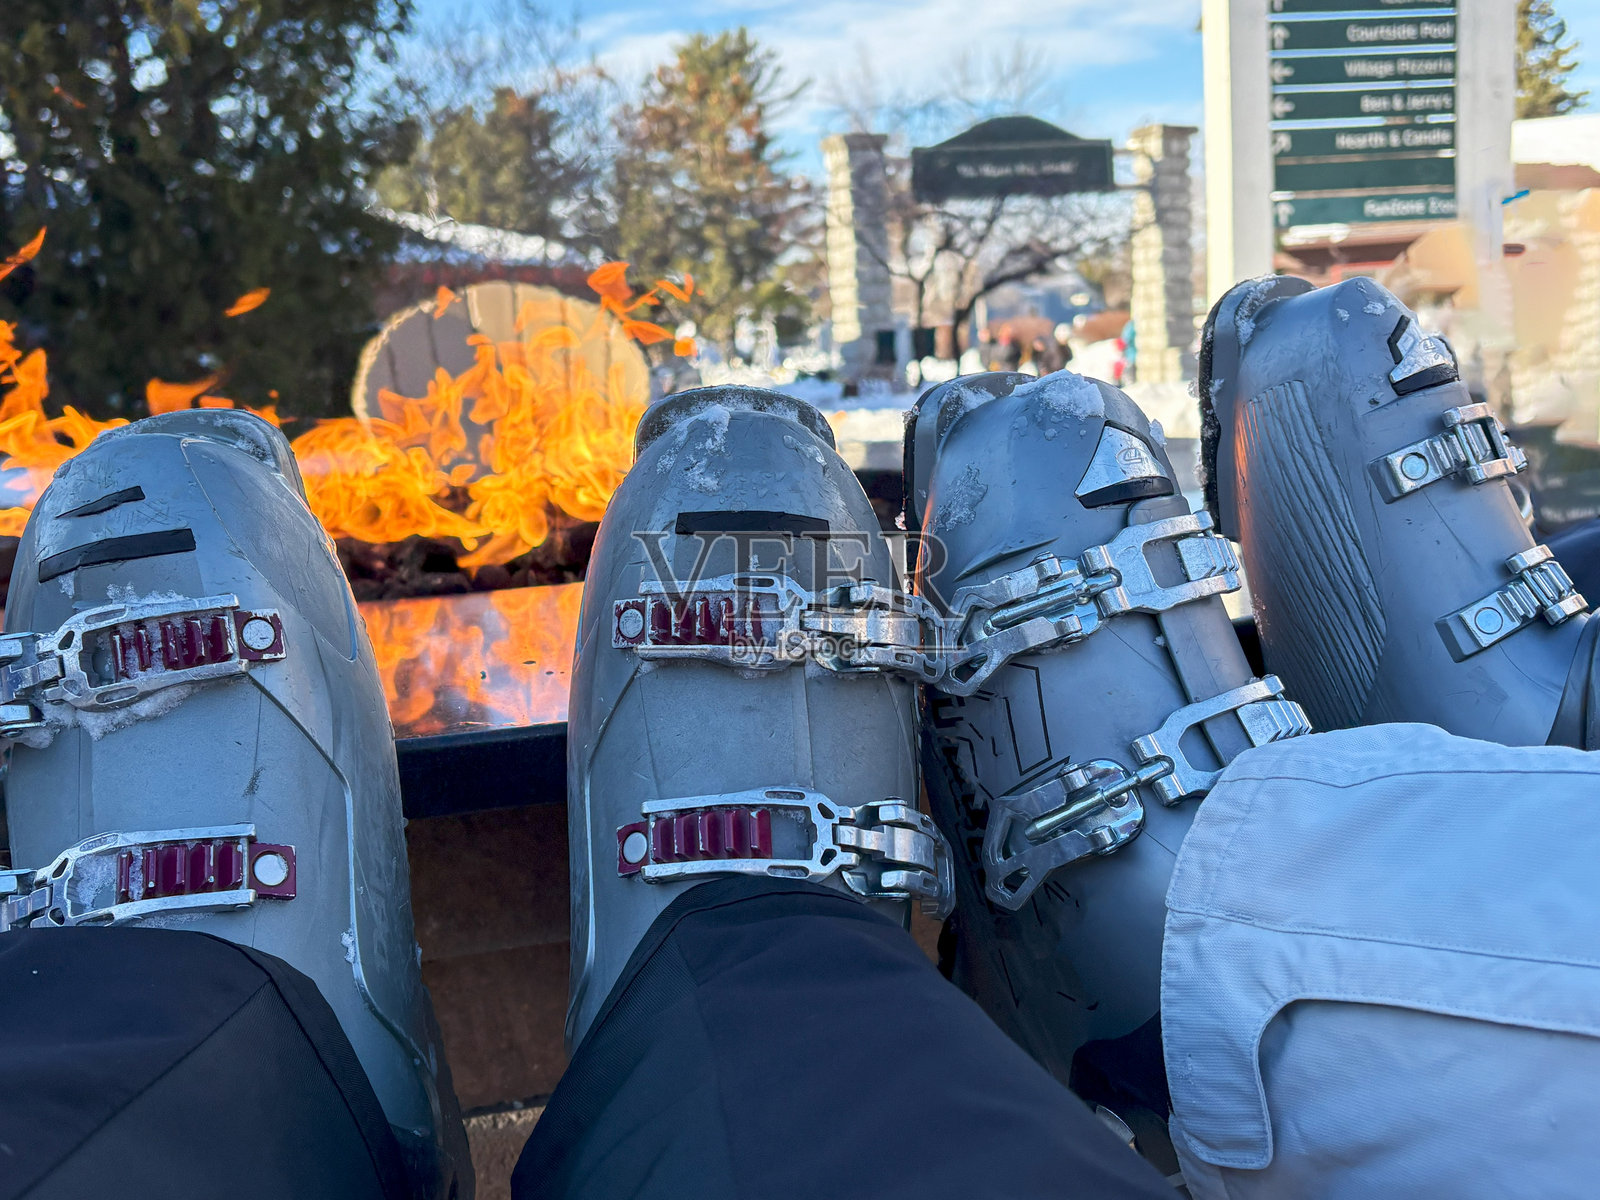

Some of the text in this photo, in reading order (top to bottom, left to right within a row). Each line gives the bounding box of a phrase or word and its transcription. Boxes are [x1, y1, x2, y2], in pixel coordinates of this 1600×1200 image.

[1346, 21, 1454, 42] Courtside Pool
[1343, 57, 1454, 78] Village Pizzeria
[1360, 92, 1453, 113] Ben & Jerry's
[1335, 127, 1453, 149] Hearth & Candle
